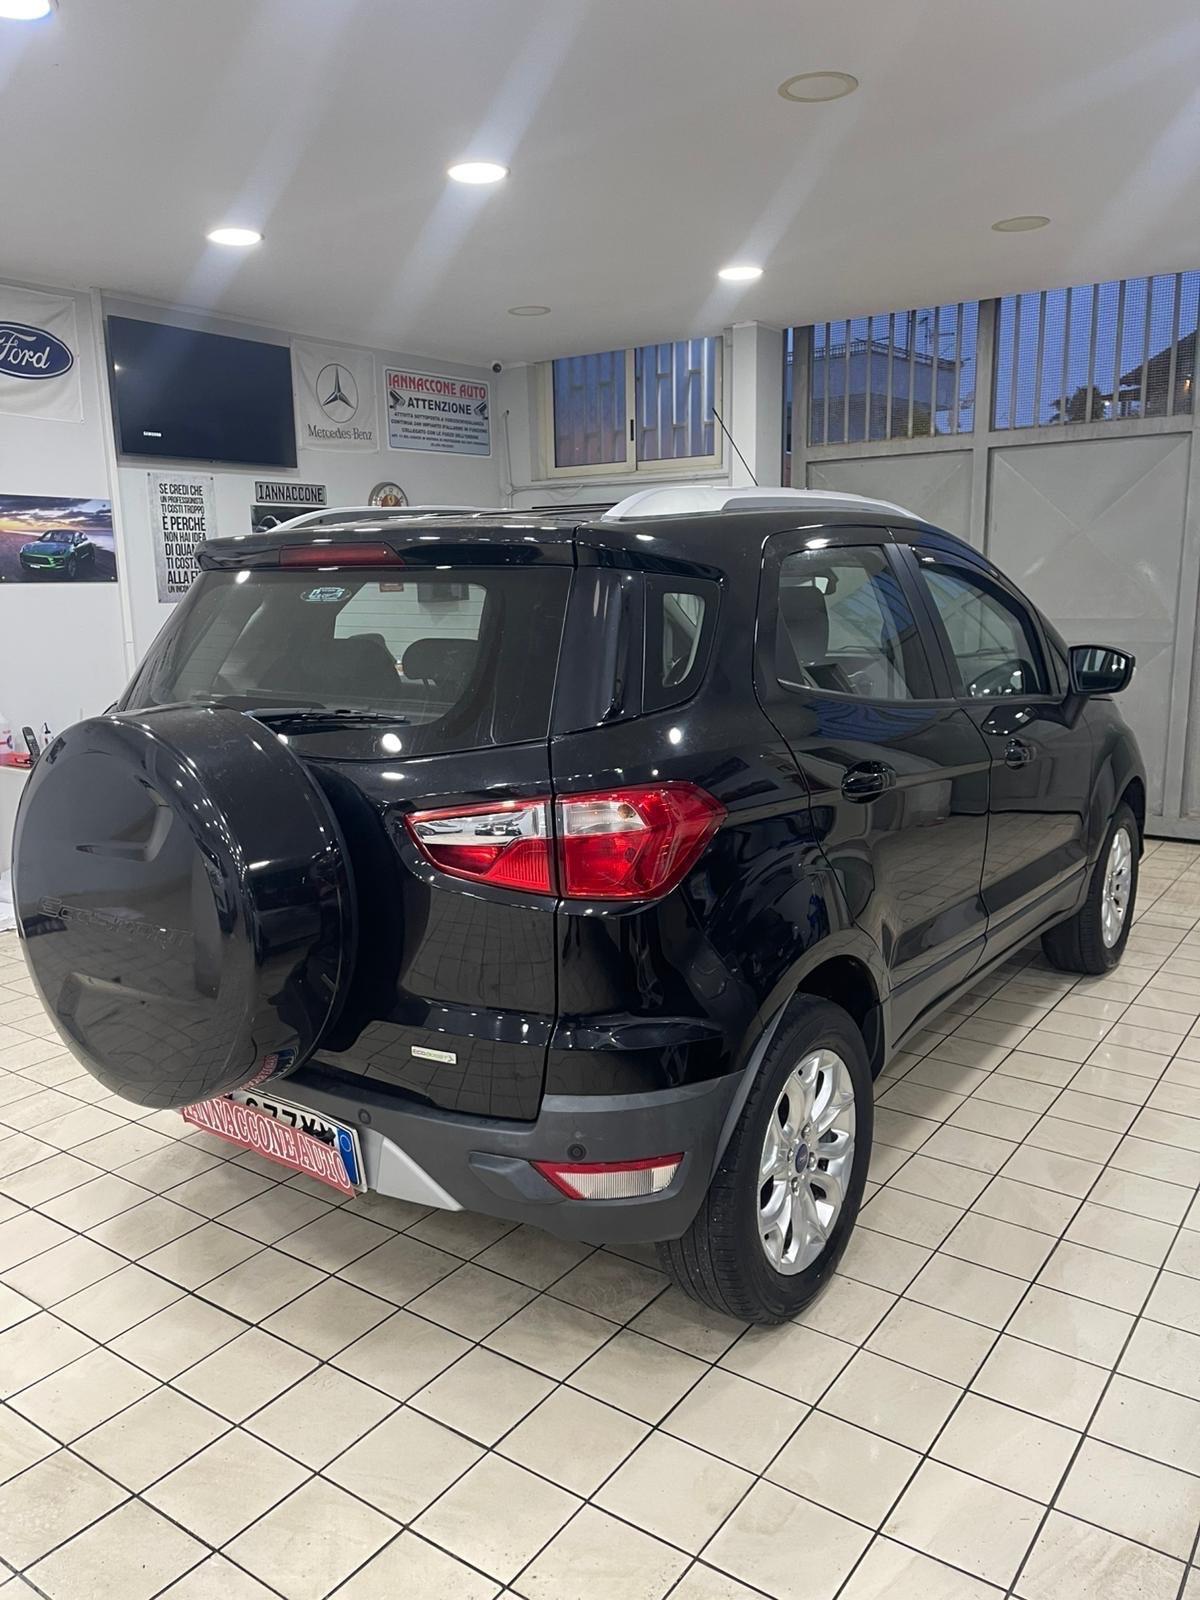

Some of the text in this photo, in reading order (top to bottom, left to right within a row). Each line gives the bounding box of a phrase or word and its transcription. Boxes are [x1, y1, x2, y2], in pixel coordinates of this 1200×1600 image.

[0, 329, 51, 369] Ford
[388, 373, 486, 399] IANNACCONE AUTO
[407, 397, 472, 415] ATTENZIONE
[307, 423, 372, 440] Mercedes-Benz
[159, 483, 202, 496] SE CREDI CHE
[258, 485, 323, 502] IANNACCONE
[160, 495, 167, 503] UN
[161, 503, 205, 514] TI COSTI TROPPO
[162, 513, 206, 531] È PERCHÉ
[164, 531, 206, 542] NON HAI IDEA
[165, 543, 174, 556] DI
[166, 557, 174, 569] TI
[168, 570, 189, 584] ALLA
[297, 1132, 351, 1188] AUTO
